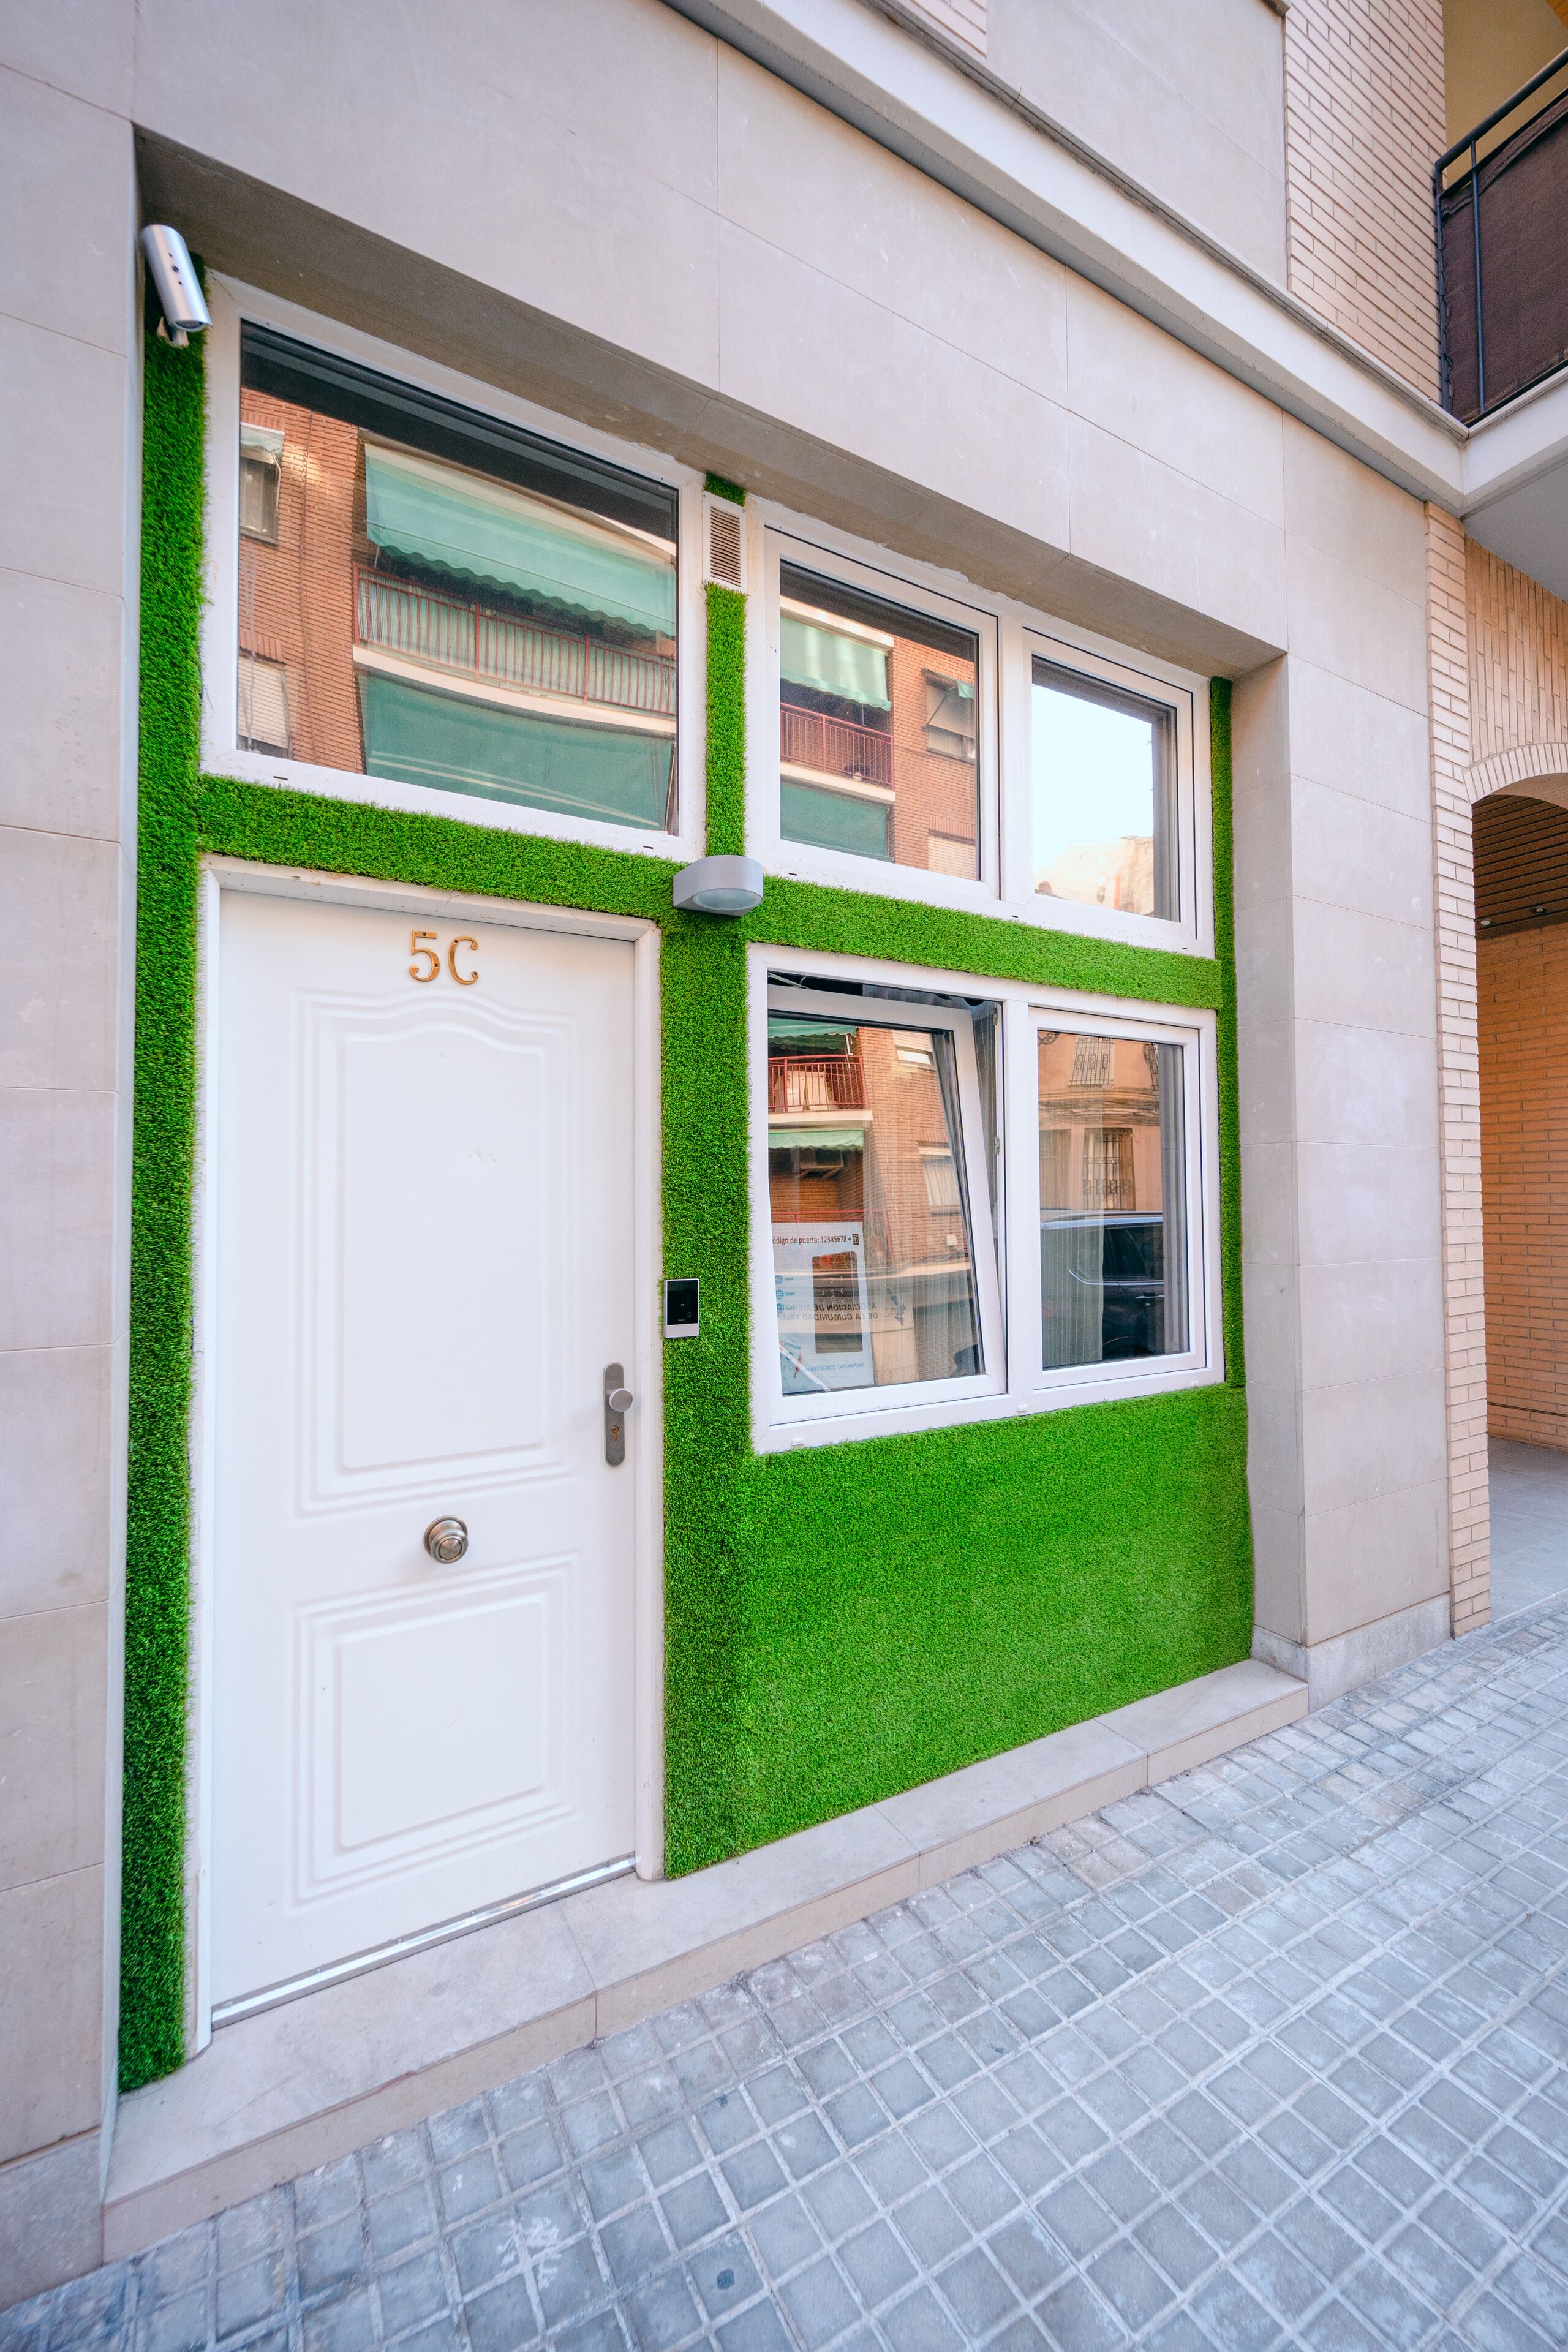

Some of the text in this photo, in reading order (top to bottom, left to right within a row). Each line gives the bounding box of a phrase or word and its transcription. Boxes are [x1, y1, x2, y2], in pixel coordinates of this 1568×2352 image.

[409, 930, 479, 985] 5C
[772, 1236, 789, 1245] ódigo
[799, 1236, 820, 1245] puerta:
